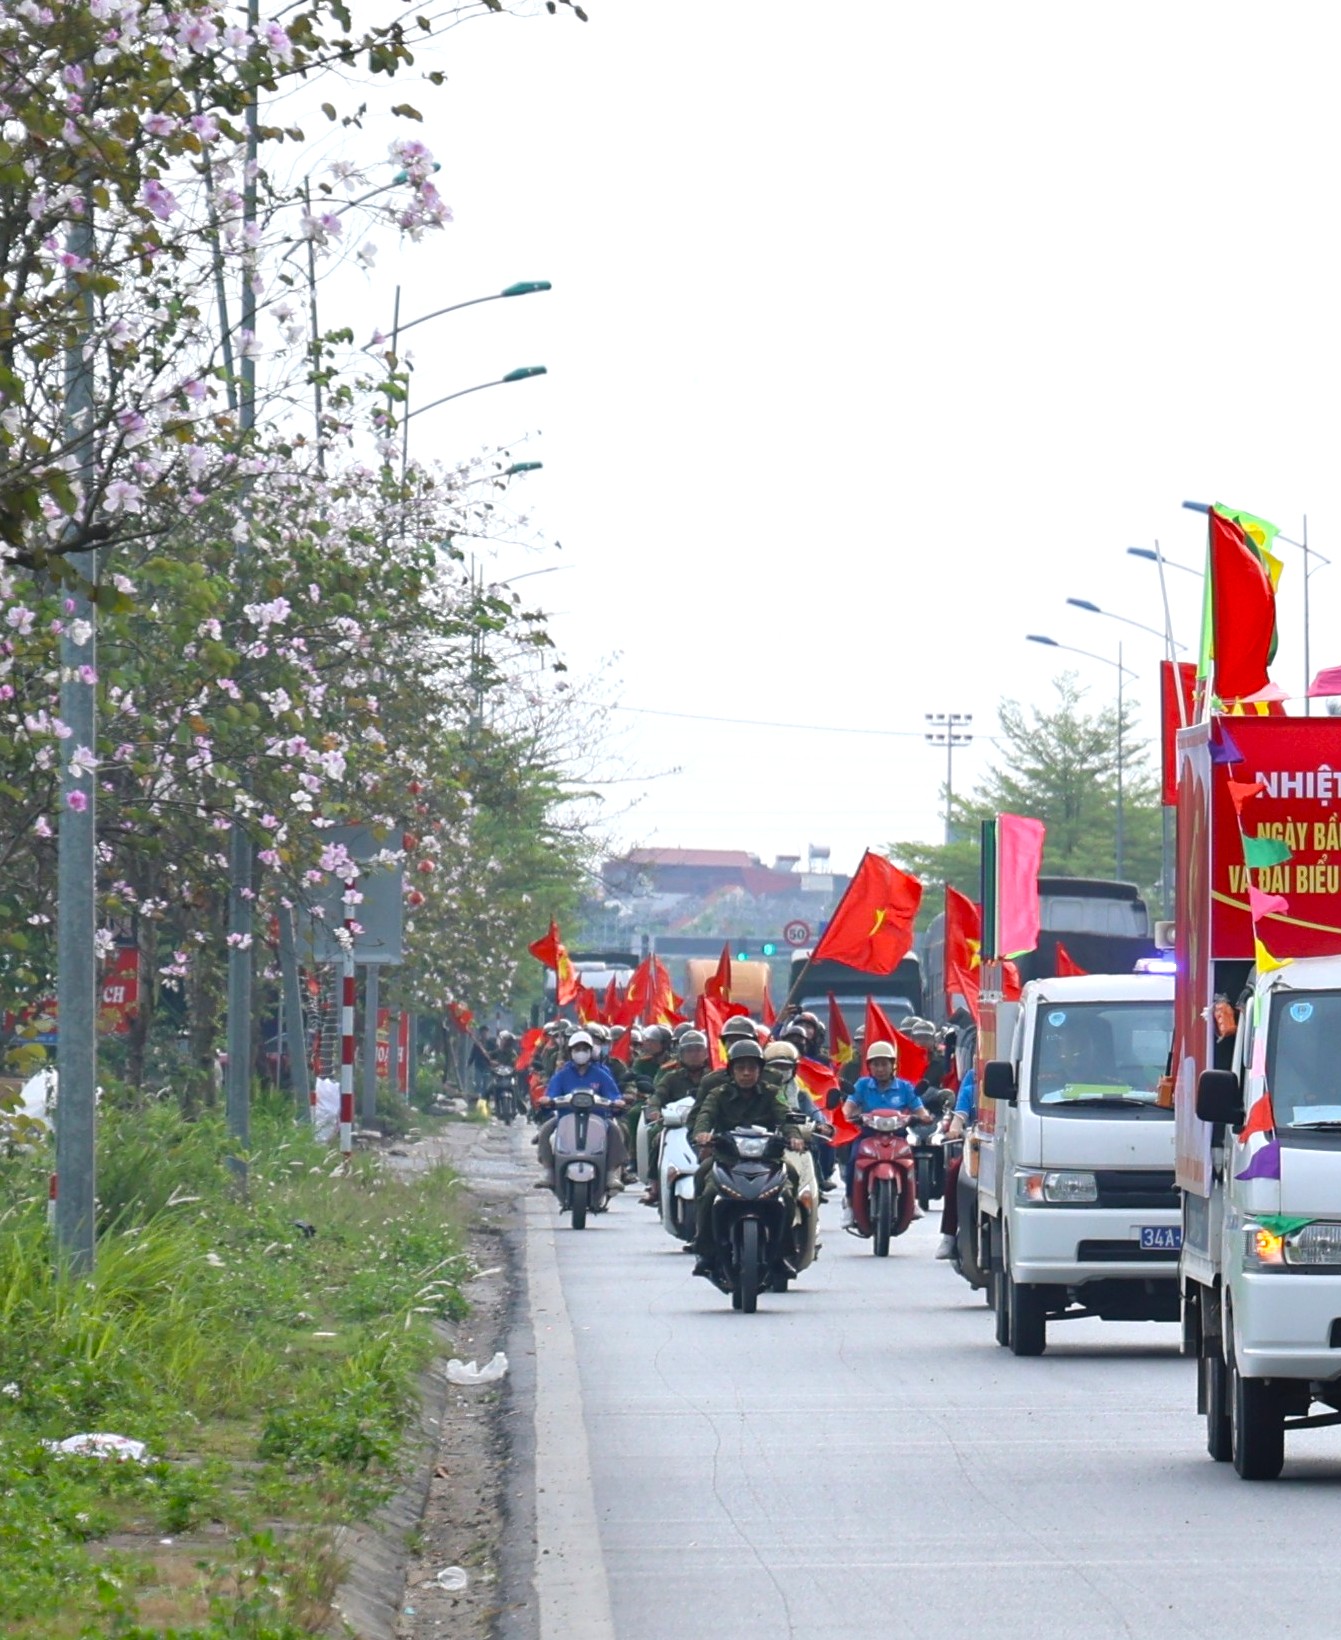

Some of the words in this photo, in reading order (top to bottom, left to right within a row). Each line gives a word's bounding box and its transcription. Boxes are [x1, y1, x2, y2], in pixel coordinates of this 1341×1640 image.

[1257, 816, 1308, 851] NGÀY
[1296, 854, 1339, 894] BIỂU
[789, 928, 805, 940] 50
